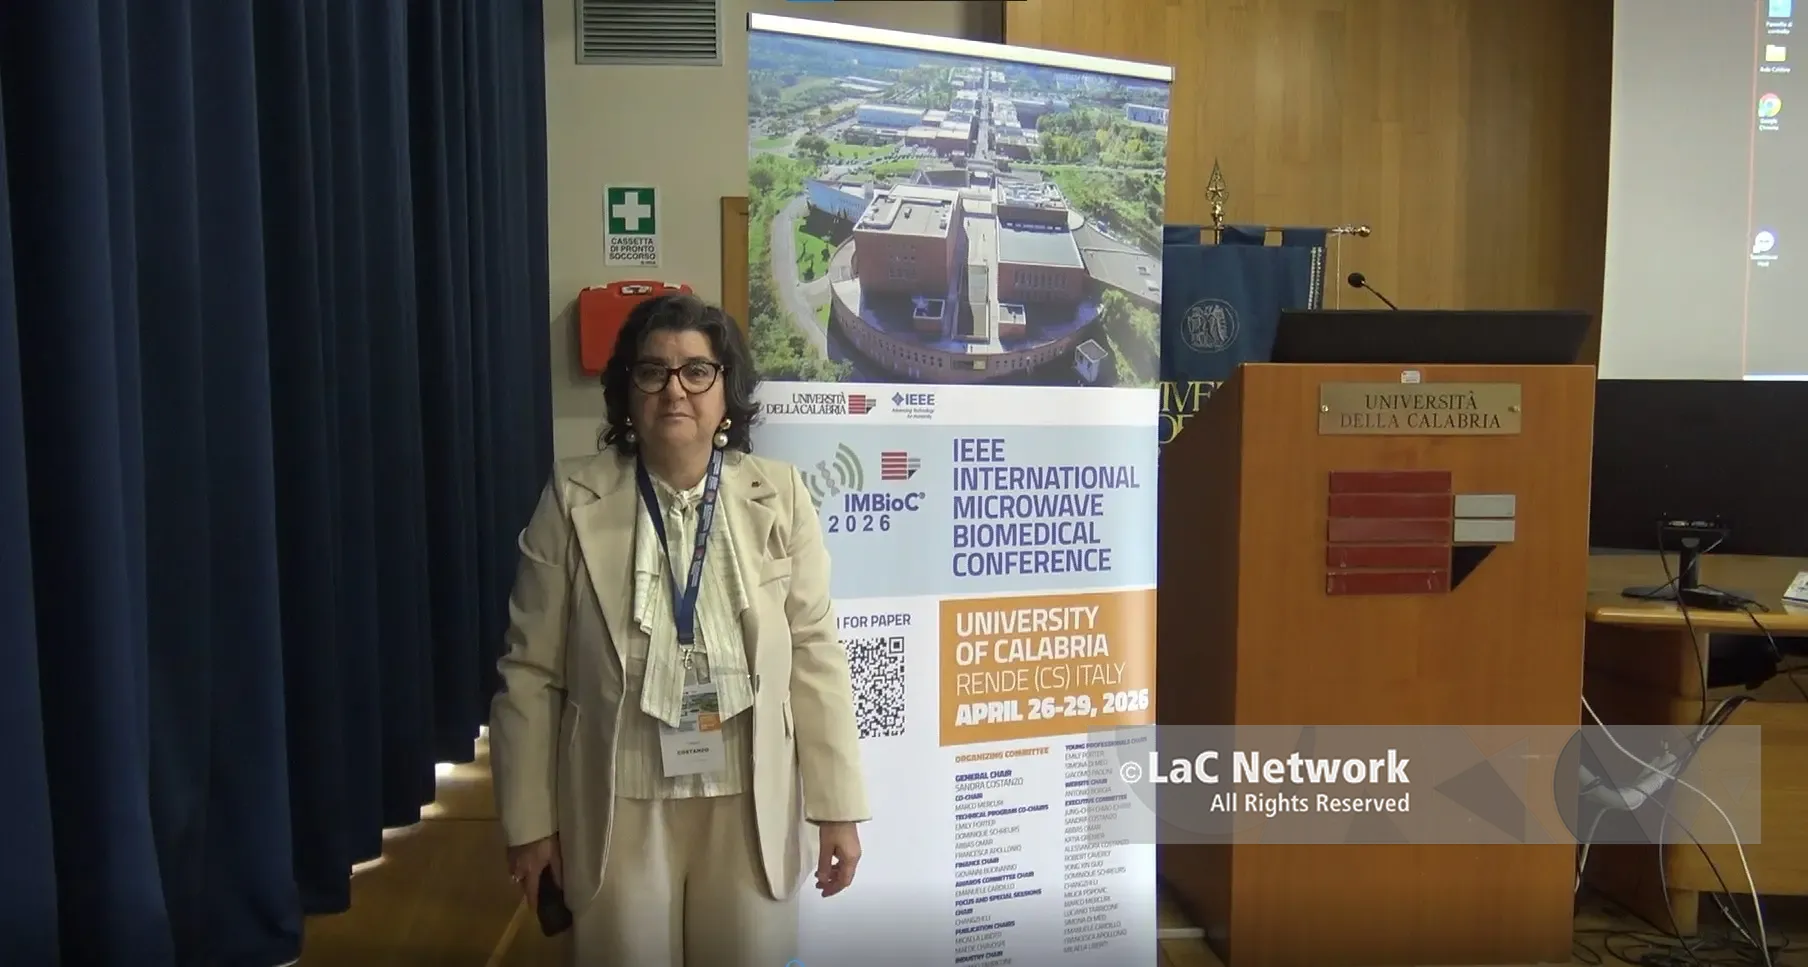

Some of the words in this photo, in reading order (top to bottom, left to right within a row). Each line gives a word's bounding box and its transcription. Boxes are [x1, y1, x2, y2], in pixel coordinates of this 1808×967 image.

[611, 237, 654, 245] CASSETTA
[792, 392, 846, 404] UNIVERSITÀ
[905, 394, 935, 405] IEEE
[1364, 390, 1478, 410] UNIVERSITÀ
[766, 404, 799, 414] DELLA
[800, 404, 846, 414] CALABRIA
[1339, 413, 1400, 429] DELLA
[1407, 413, 1502, 429] CALABRIA
[953, 438, 1005, 462] IEEE
[953, 466, 1140, 491] INTERNATIONAL
[953, 494, 1104, 519] MICROWAVE
[828, 514, 891, 533] 2026
[953, 521, 1101, 548] BIOMEDICAL
[952, 548, 1111, 577] CONFERENCE
[843, 616, 868, 628] FOR
[870, 613, 911, 627] PAPER
[956, 605, 1100, 637] UNIVERSITY
[956, 641, 989, 666] OF
[994, 633, 1109, 664] CALABRIA
[956, 668, 1029, 696] RENDE
[1034, 664, 1071, 692] (CS)
[1076, 662, 1126, 687] ITALY
[955, 700, 1024, 727] APRIL
[1028, 695, 1098, 721] 26-29,
[1102, 688, 1149, 714] 2026
[677, 747, 709, 755] COSTANZO
[956, 752, 1002, 763] ORGANIZING
[1005, 747, 1049, 758] COMMITTEE
[956, 772, 988, 782] GENERAL
[990, 770, 1012, 778] CHAIR
[955, 781, 985, 792] SANDRA
[986, 778, 1024, 788] COSTANZO
[955, 793, 983, 801] CO-CHAIR
[982, 857, 999, 865] CHAIR
[1017, 871, 1034, 879] CHAIR
[955, 898, 974, 906] FOCUS
[989, 893, 1012, 901] SPECIAL
[994, 921, 1015, 929] CHAIRS
[955, 954, 984, 964] INDUSTRY
[986, 951, 1002, 959] CHAIR
